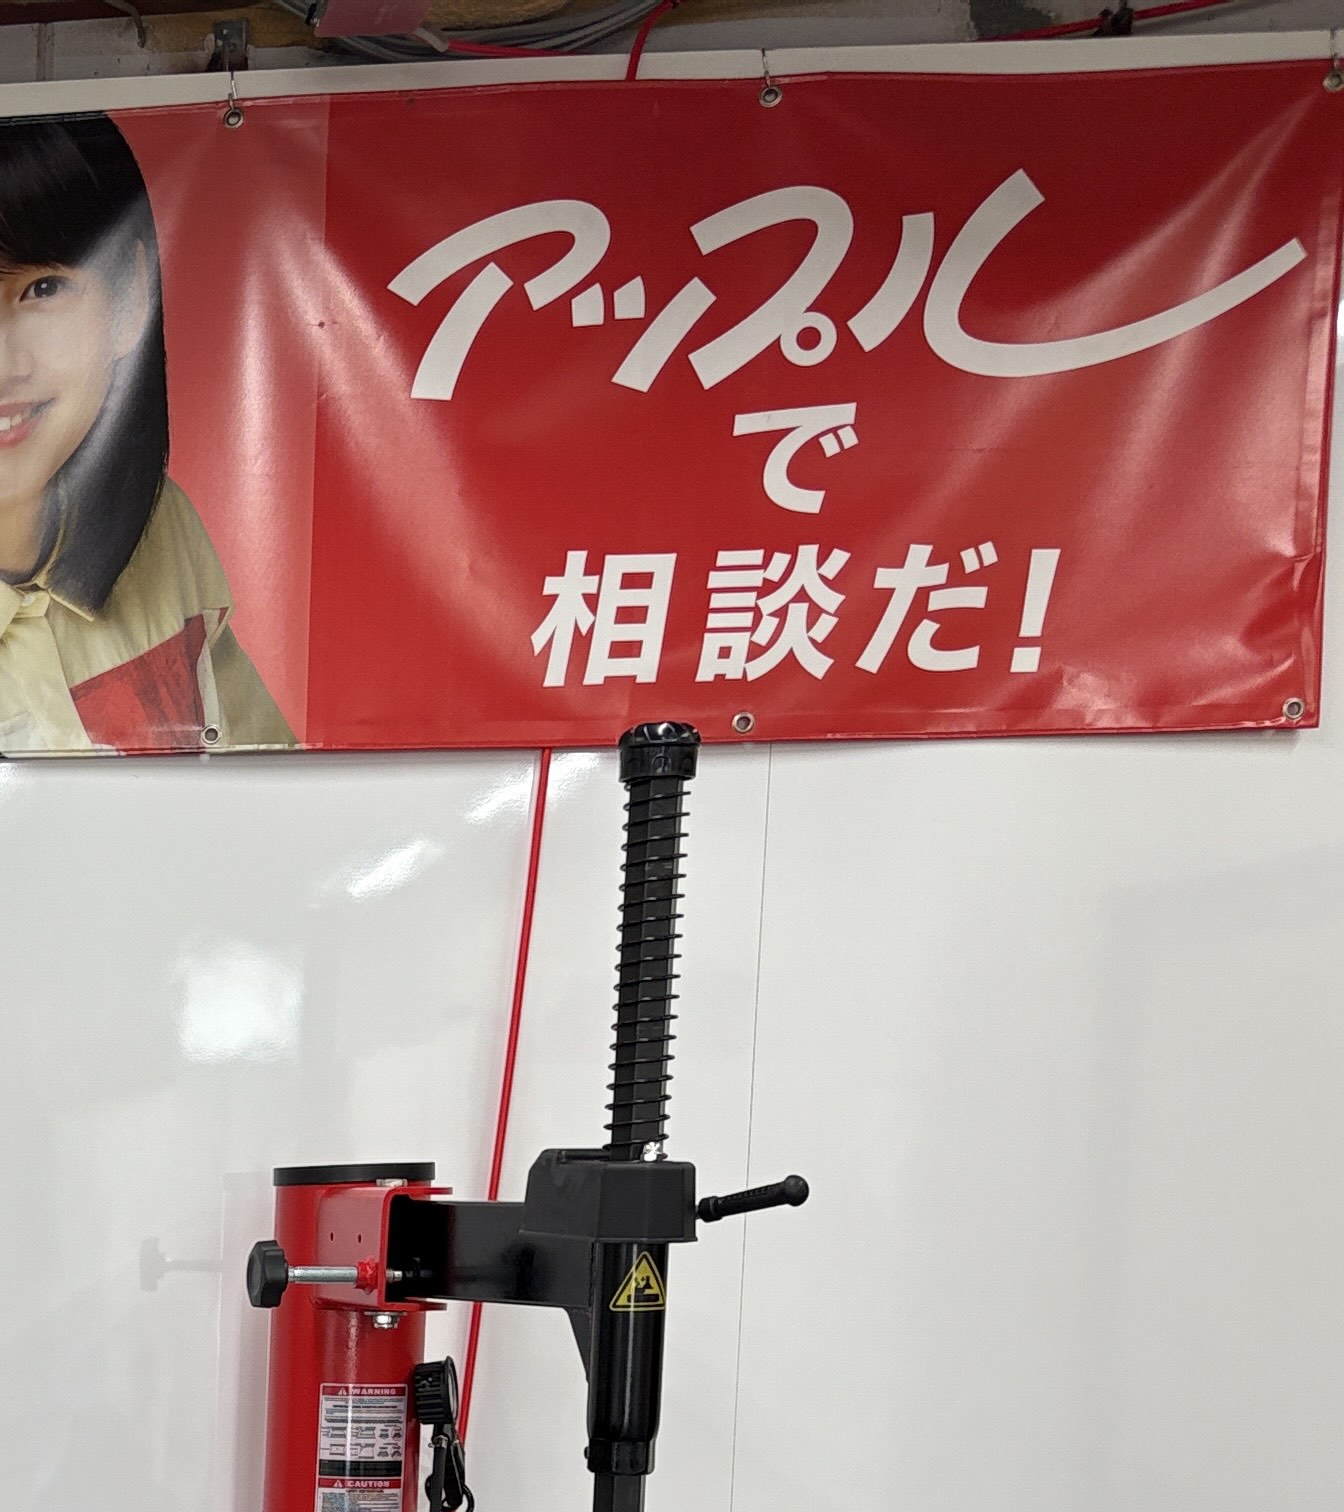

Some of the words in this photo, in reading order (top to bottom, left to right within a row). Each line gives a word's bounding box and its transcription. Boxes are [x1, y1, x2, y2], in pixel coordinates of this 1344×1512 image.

[386, 168, 1308, 401] アップル
[733, 402, 859, 515] で
